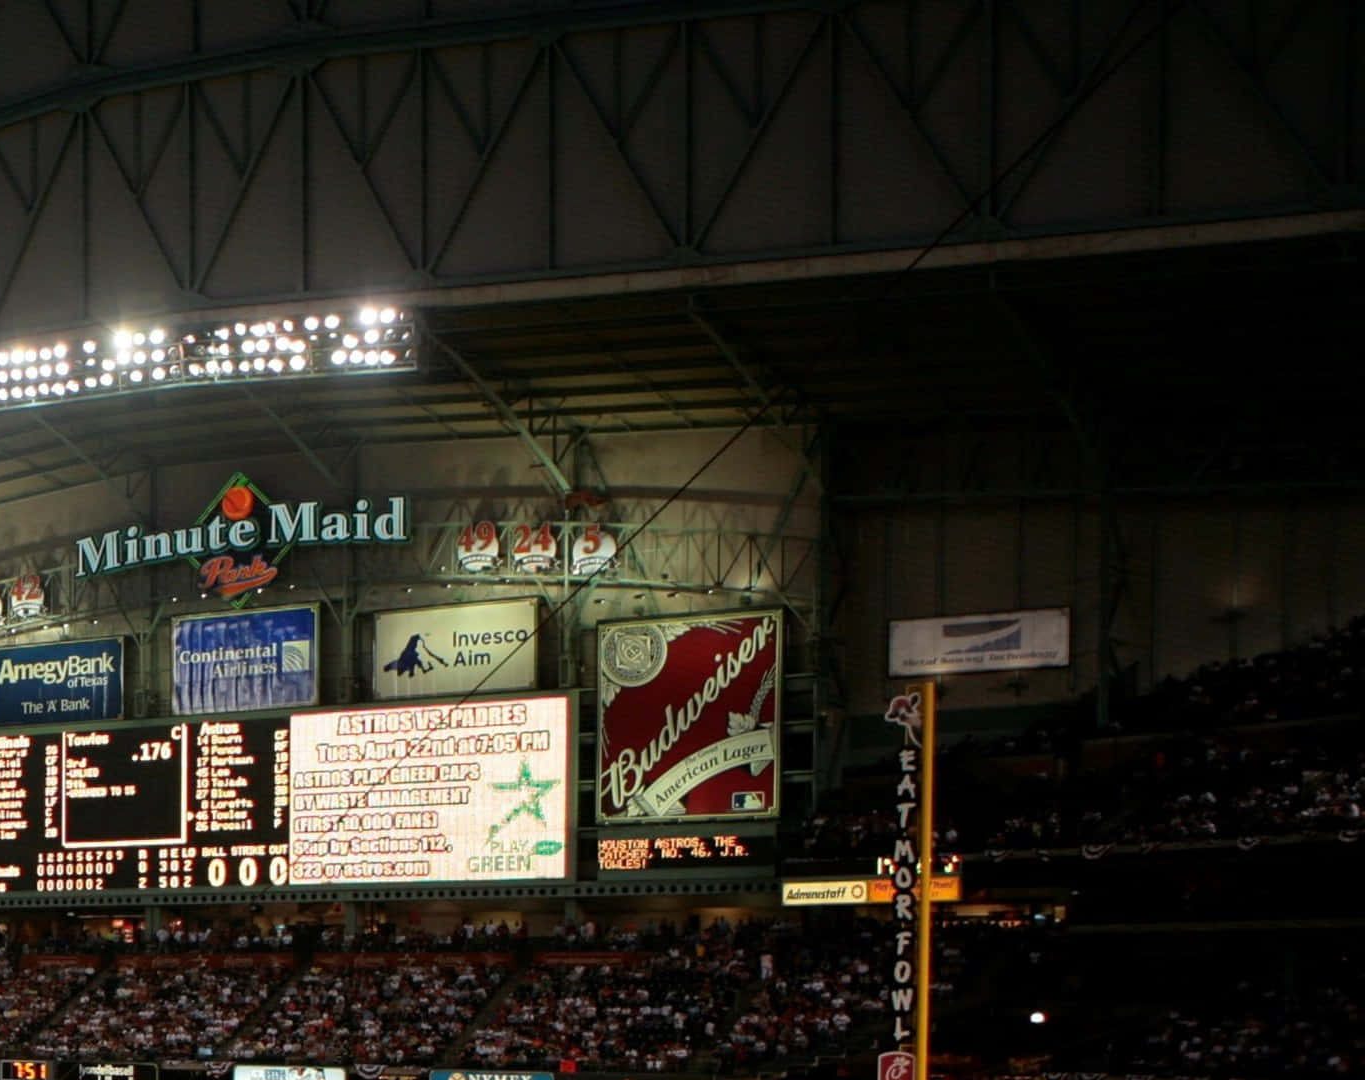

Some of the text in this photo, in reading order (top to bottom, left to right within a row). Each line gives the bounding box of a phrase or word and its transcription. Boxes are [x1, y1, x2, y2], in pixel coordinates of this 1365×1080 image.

[75, 496, 408, 577] Minute Maid
[458, 520, 495, 552] 49
[513, 520, 552, 554] 24
[583, 523, 601, 554] 5
[200, 554, 276, 593] Park
[11, 575, 40, 600] 42
[452, 628, 528, 648] Invesco
[179, 642, 278, 665] Continental
[453, 651, 491, 667] Aim
[214, 661, 278, 678] Airlines
[67, 675, 109, 689] of Texas
[21, 697, 90, 714] The Bank
[600, 616, 775, 809] Budweiser
[337, 711, 413, 736] ASTROS
[449, 704, 527, 728] PADRES
[211, 734, 243, 745] Bourn
[365, 739, 408, 761] April
[409, 735, 455, 758] 22nd
[456, 735, 476, 755] at
[477, 732, 518, 755] 7:05
[519, 730, 550, 751] PM
[131, 741, 172, 762] .176
[211, 767, 231, 777] Lee
[211, 776, 248, 787] Tejada
[294, 763, 481, 789] ASTROS PLAY GREEN CAPS
[654, 751, 719, 809] American
[722, 742, 767, 761] Lager
[294, 786, 472, 811] BY WASTE MANAGEMENT
[294, 810, 439, 833] (FIRST 10,000 FANS)
[201, 844, 289, 858] BALL STRIKE OUT
[330, 836, 419, 857] by Sections
[490, 839, 529, 853] PLAY
[597, 835, 737, 851] HOUSTON THE
[597, 846, 749, 860] CATCHER, NO. 46, J.R.
[208, 856, 289, 887] 0 0 0
[293, 860, 430, 879] 323 or astros.com
[469, 855, 532, 873] GREEN
[597, 859, 647, 870] TOWLES!
[787, 887, 847, 901] Administaff
[891, 749, 917, 1041] EAT MOR FOWL
